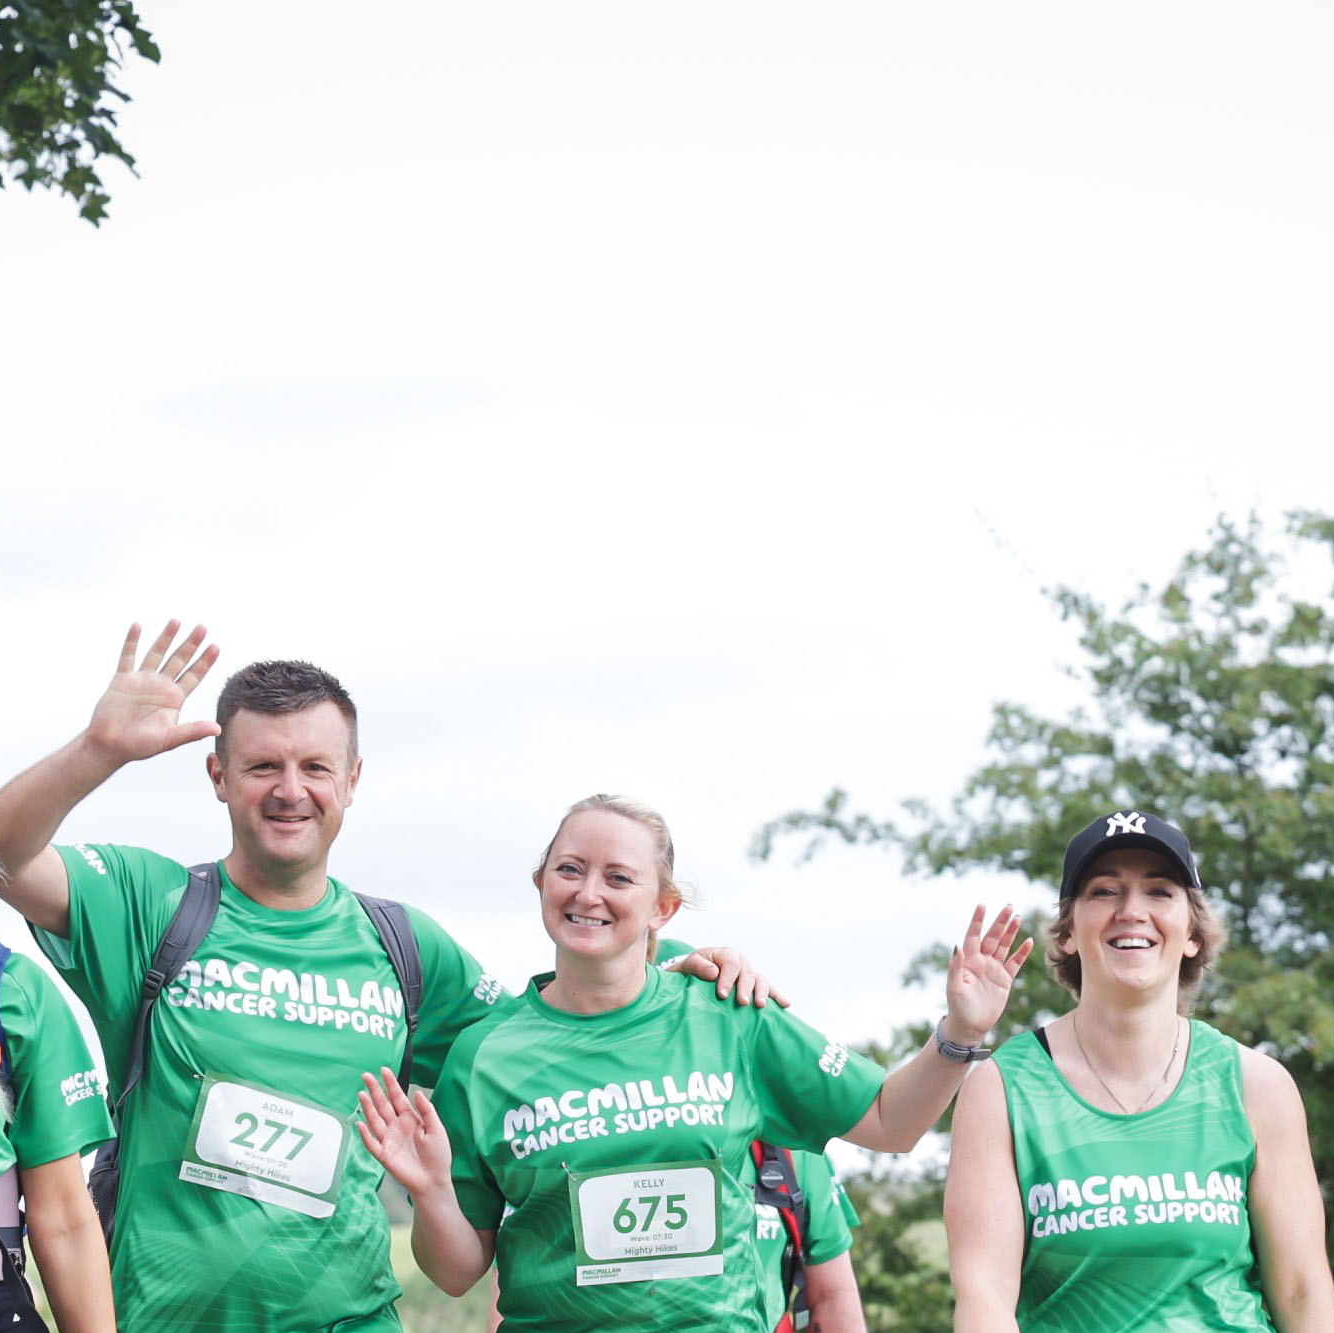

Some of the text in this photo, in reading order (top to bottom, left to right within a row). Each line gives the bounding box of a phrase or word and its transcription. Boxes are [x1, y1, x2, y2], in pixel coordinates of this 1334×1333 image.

[1106, 812, 1147, 837] NY
[168, 987, 395, 1040] CANCER SUPPORT
[262, 1102, 293, 1118] ADAM
[503, 1071, 734, 1141] MACMILLAN
[229, 1111, 314, 1161] 277
[511, 1103, 724, 1160] CANCER SUPPORT
[235, 1160, 292, 1182] Mighty Hikes
[633, 1178, 665, 1189] KELLY
[1027, 1171, 1243, 1216] MACMILLAN
[613, 1194, 688, 1234] 675
[1032, 1201, 1240, 1238] CANCER SUPPORT
[624, 1244, 678, 1256] Mighty Hikes
